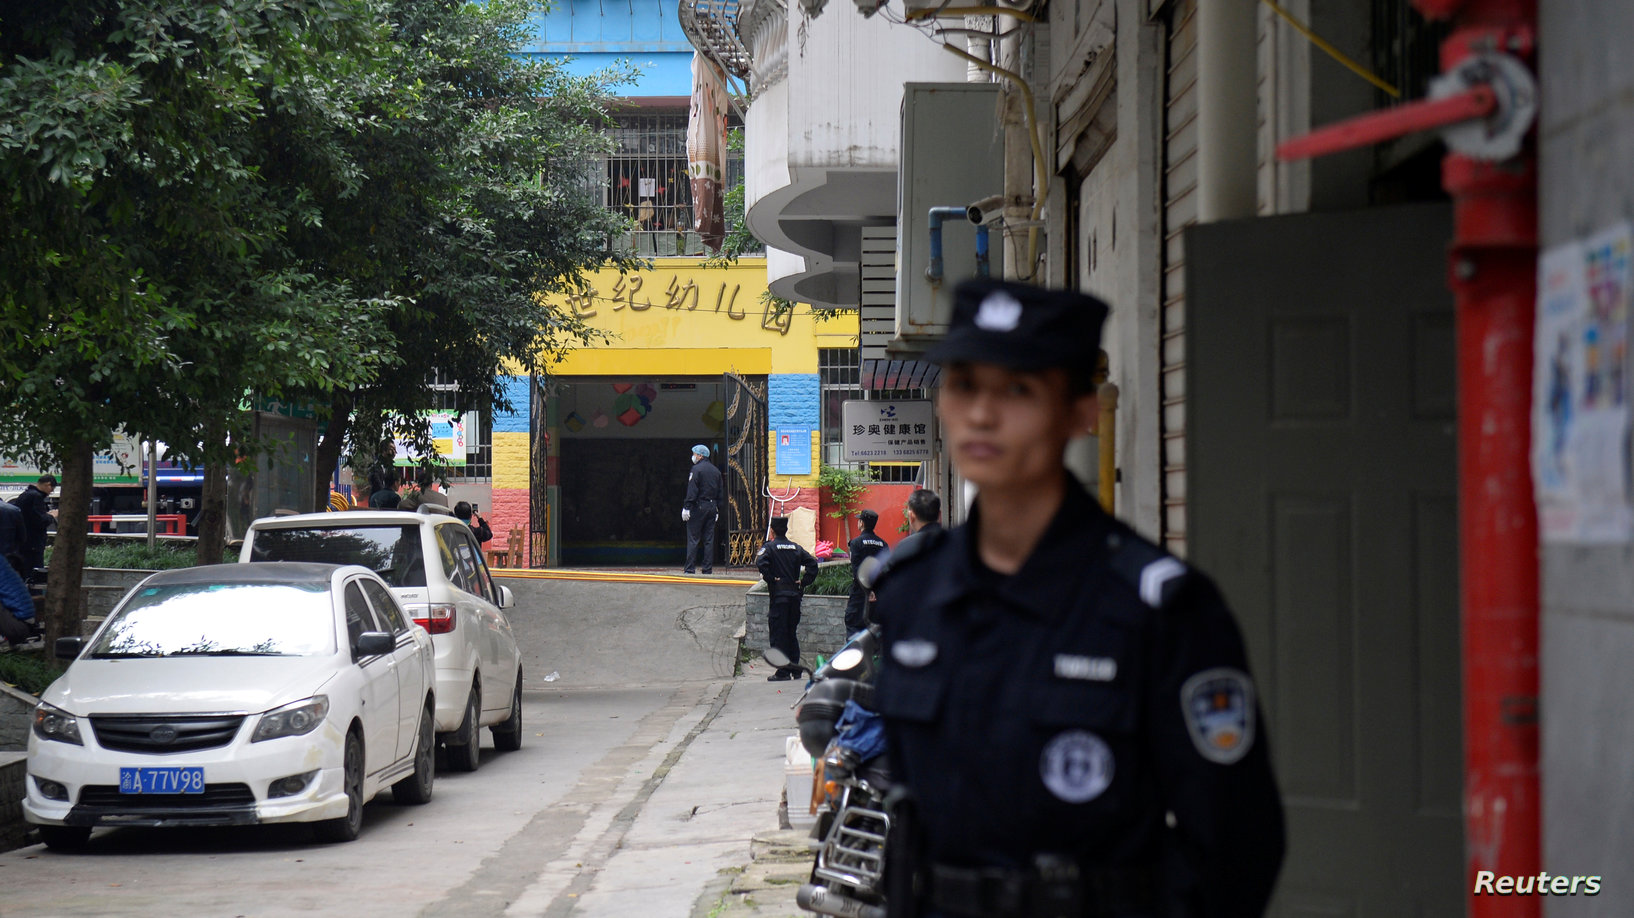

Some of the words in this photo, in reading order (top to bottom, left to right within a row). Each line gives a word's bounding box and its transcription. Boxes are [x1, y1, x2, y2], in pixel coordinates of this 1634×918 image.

[852, 423, 926, 436] 珍奥健康馆
